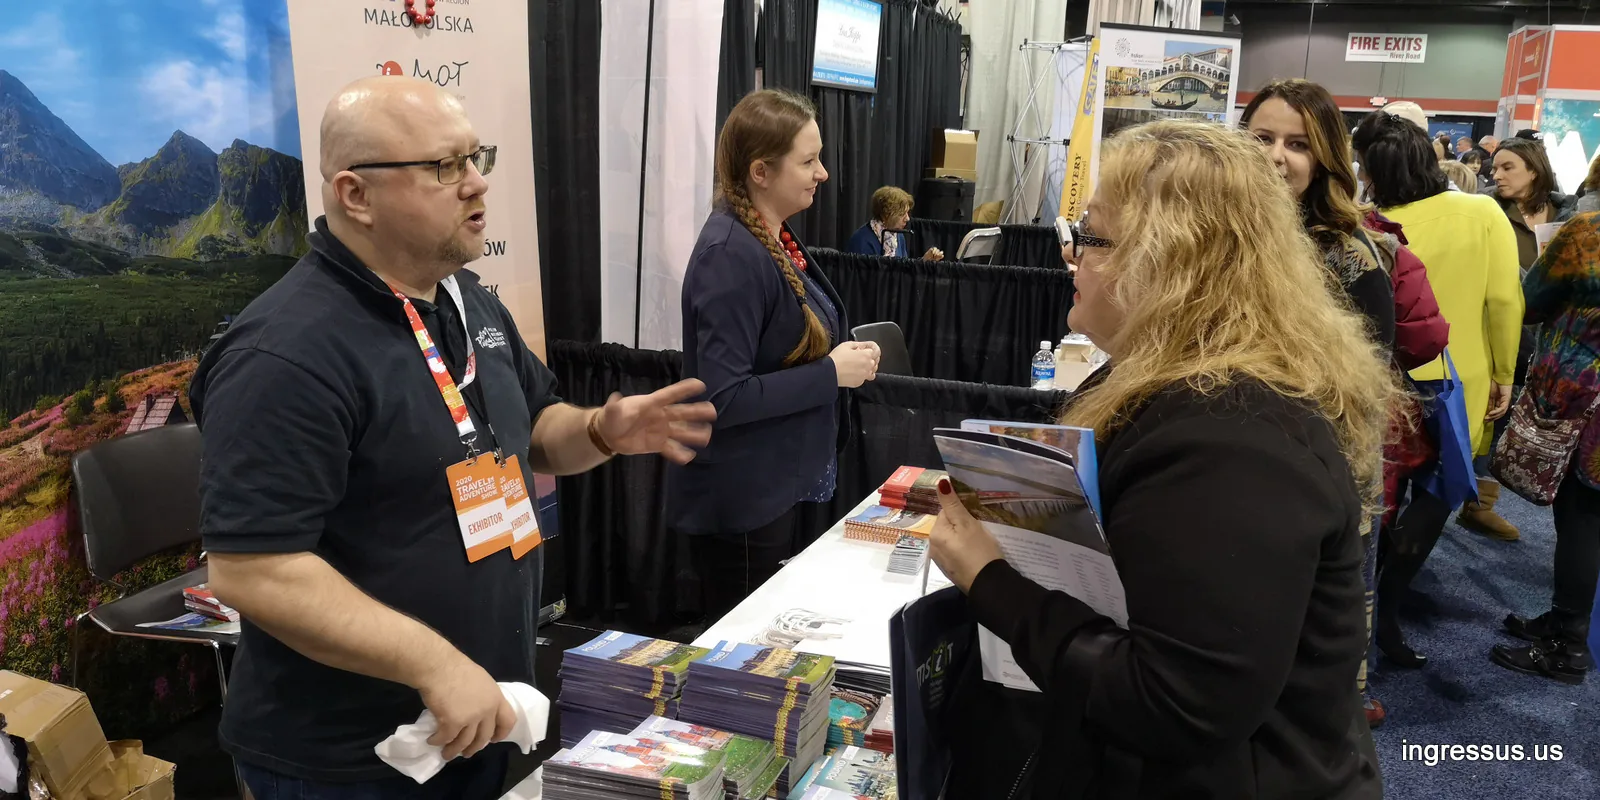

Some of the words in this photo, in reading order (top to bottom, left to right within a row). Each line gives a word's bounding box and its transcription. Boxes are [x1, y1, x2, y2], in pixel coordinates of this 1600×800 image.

[364, 8, 474, 33] MAŁOOLSKA
[1350, 36, 1380, 50] FIRE
[1384, 37, 1422, 51] EXITS
[456, 475, 473, 487] 2020
[457, 479, 488, 495] TRAVEL
[501, 479, 516, 493] RAVEL
[459, 482, 497, 503] ADVENTURE
[481, 489, 498, 500] SHOW
[503, 484, 522, 498] VENTURE
[468, 512, 504, 535] EXHIBITOR
[510, 511, 531, 531] XHIBITOR
